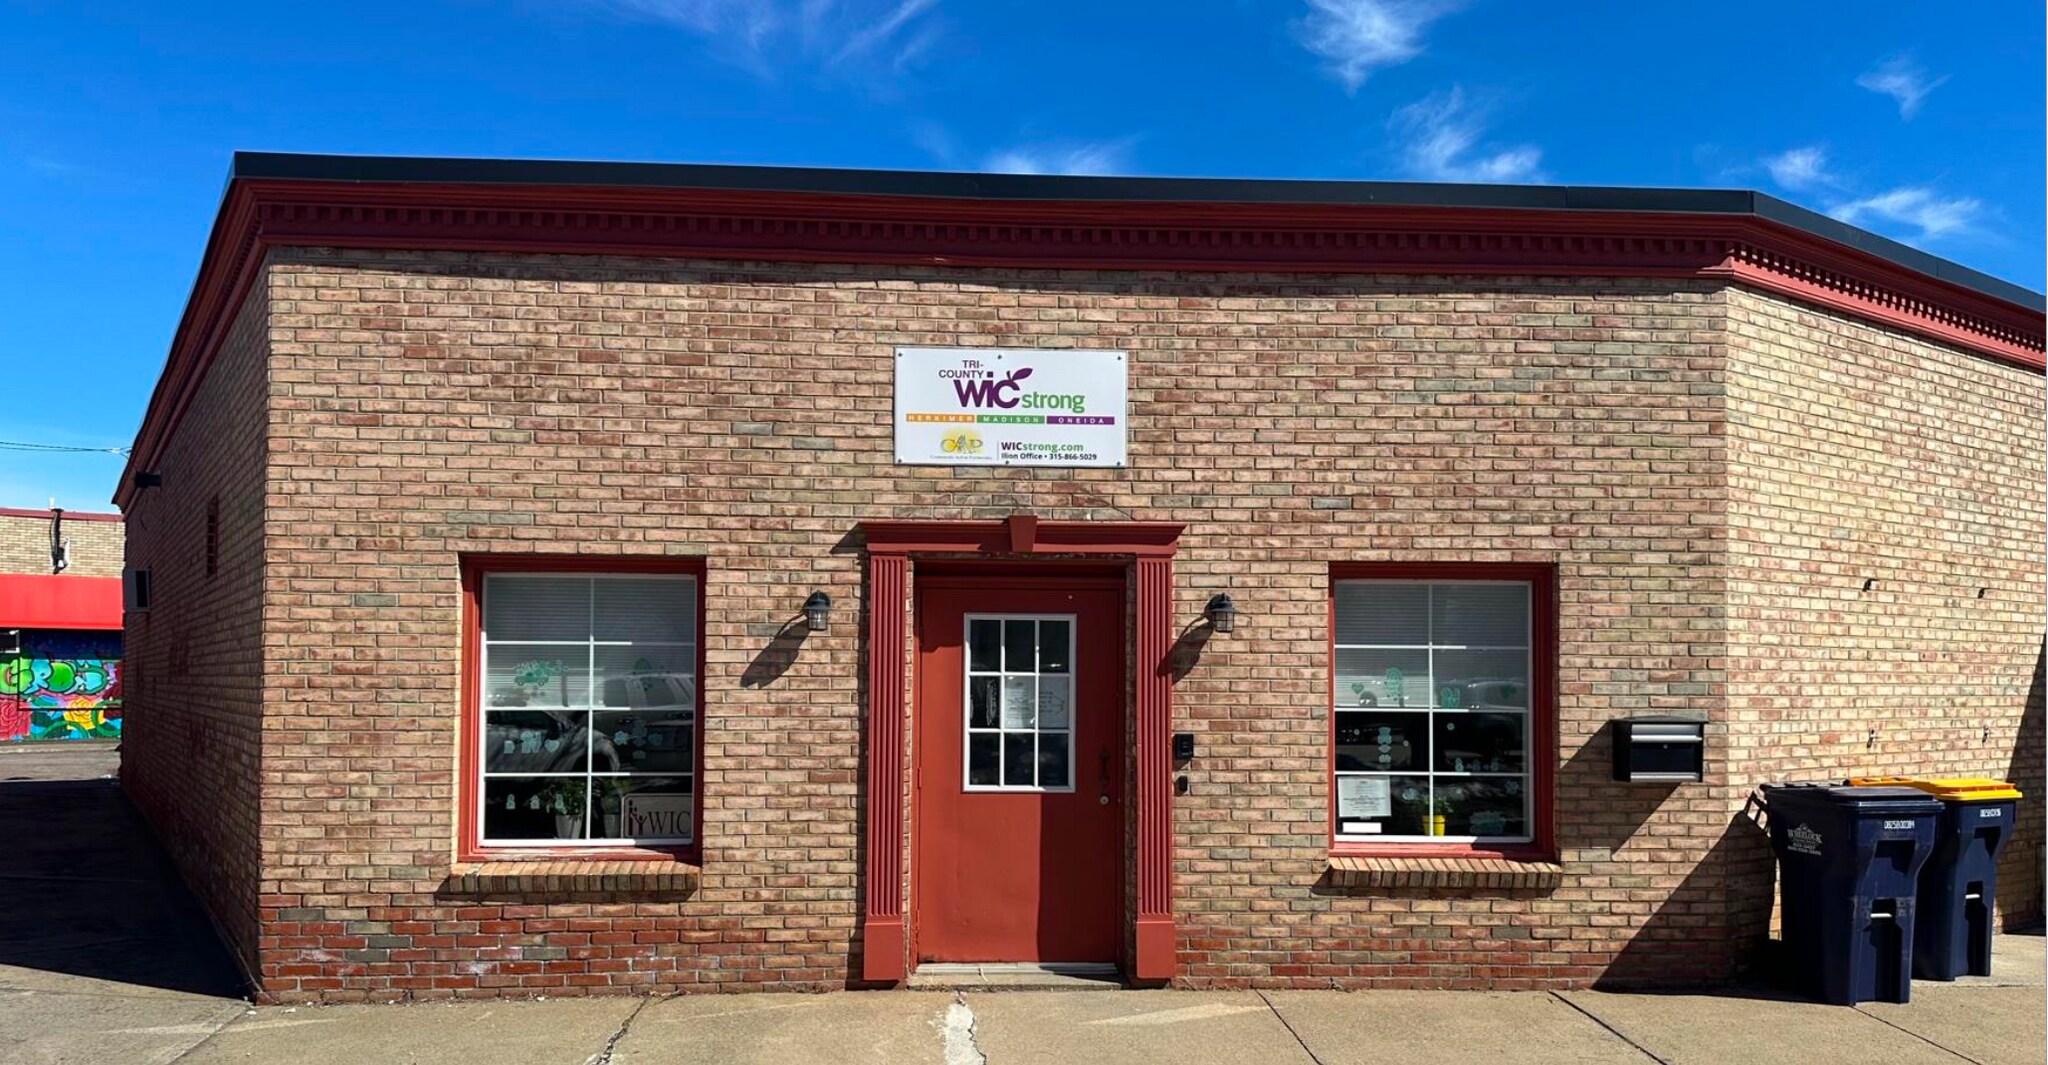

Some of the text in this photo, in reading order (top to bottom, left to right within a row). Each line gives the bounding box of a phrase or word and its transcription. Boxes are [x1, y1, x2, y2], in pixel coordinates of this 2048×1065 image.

[962, 360, 984, 369] TRI-
[938, 369, 984, 379] COUNTY
[1021, 391, 1085, 414] strong
[1001, 441, 1084, 453] WICstrong.com
[1020, 452, 1043, 460] Office
[1049, 453, 1097, 461] 315-866-5029
[647, 810, 691, 835] WIC
